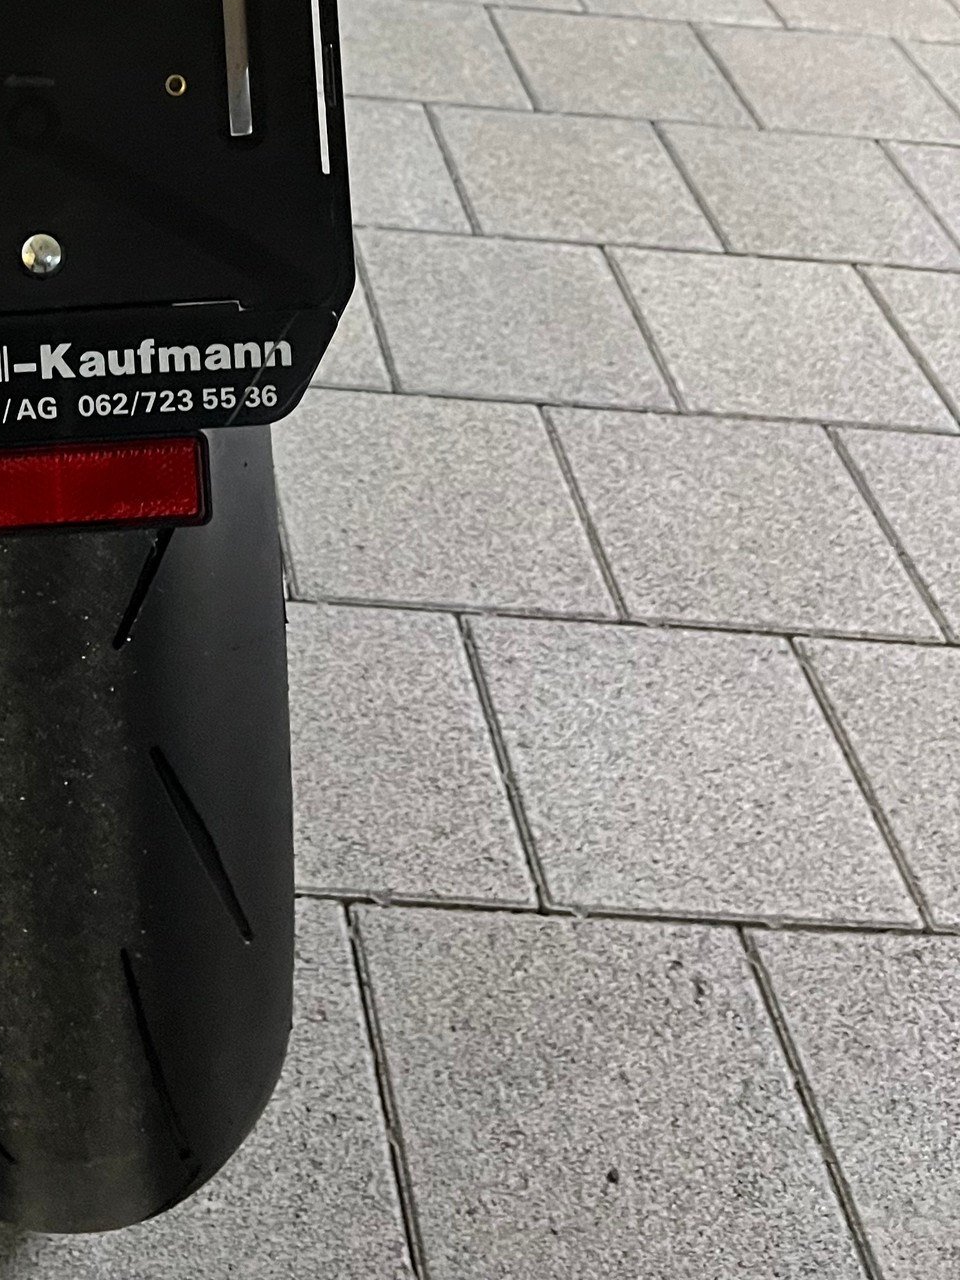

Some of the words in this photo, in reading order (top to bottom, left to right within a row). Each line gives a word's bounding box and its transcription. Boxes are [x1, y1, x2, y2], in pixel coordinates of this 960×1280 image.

[78, 389, 194, 418] 062/723
[202, 387, 237, 410] 55
[244, 384, 278, 408] 36
